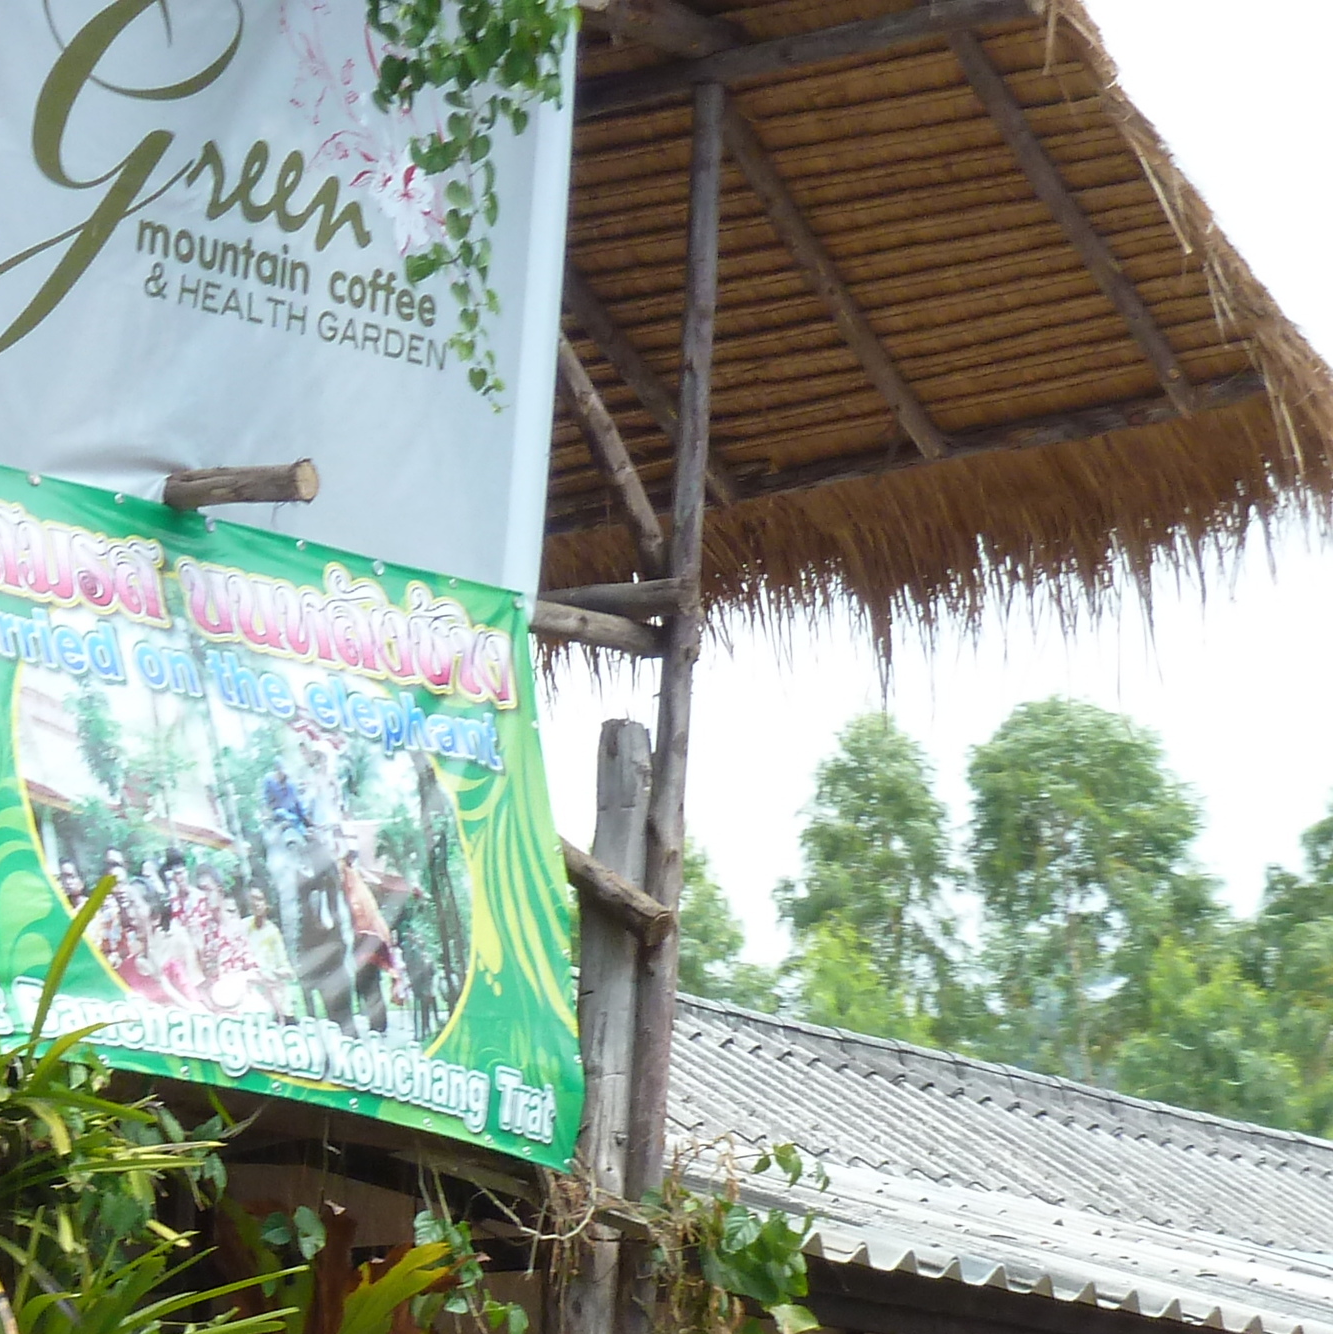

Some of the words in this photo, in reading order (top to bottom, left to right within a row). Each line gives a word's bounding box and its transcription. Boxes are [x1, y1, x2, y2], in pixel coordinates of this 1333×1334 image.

[136, 218, 309, 295] mountain
[329, 268, 436, 327] coffee
[144, 262, 168, 299] &
[178, 274, 308, 335] HEALTH
[318, 310, 449, 370] GARDEN
[132, 640, 203, 698] on
[205, 649, 295, 718] the
[304, 675, 503, 771] elephant
[494, 1065, 556, 1144] Trat
